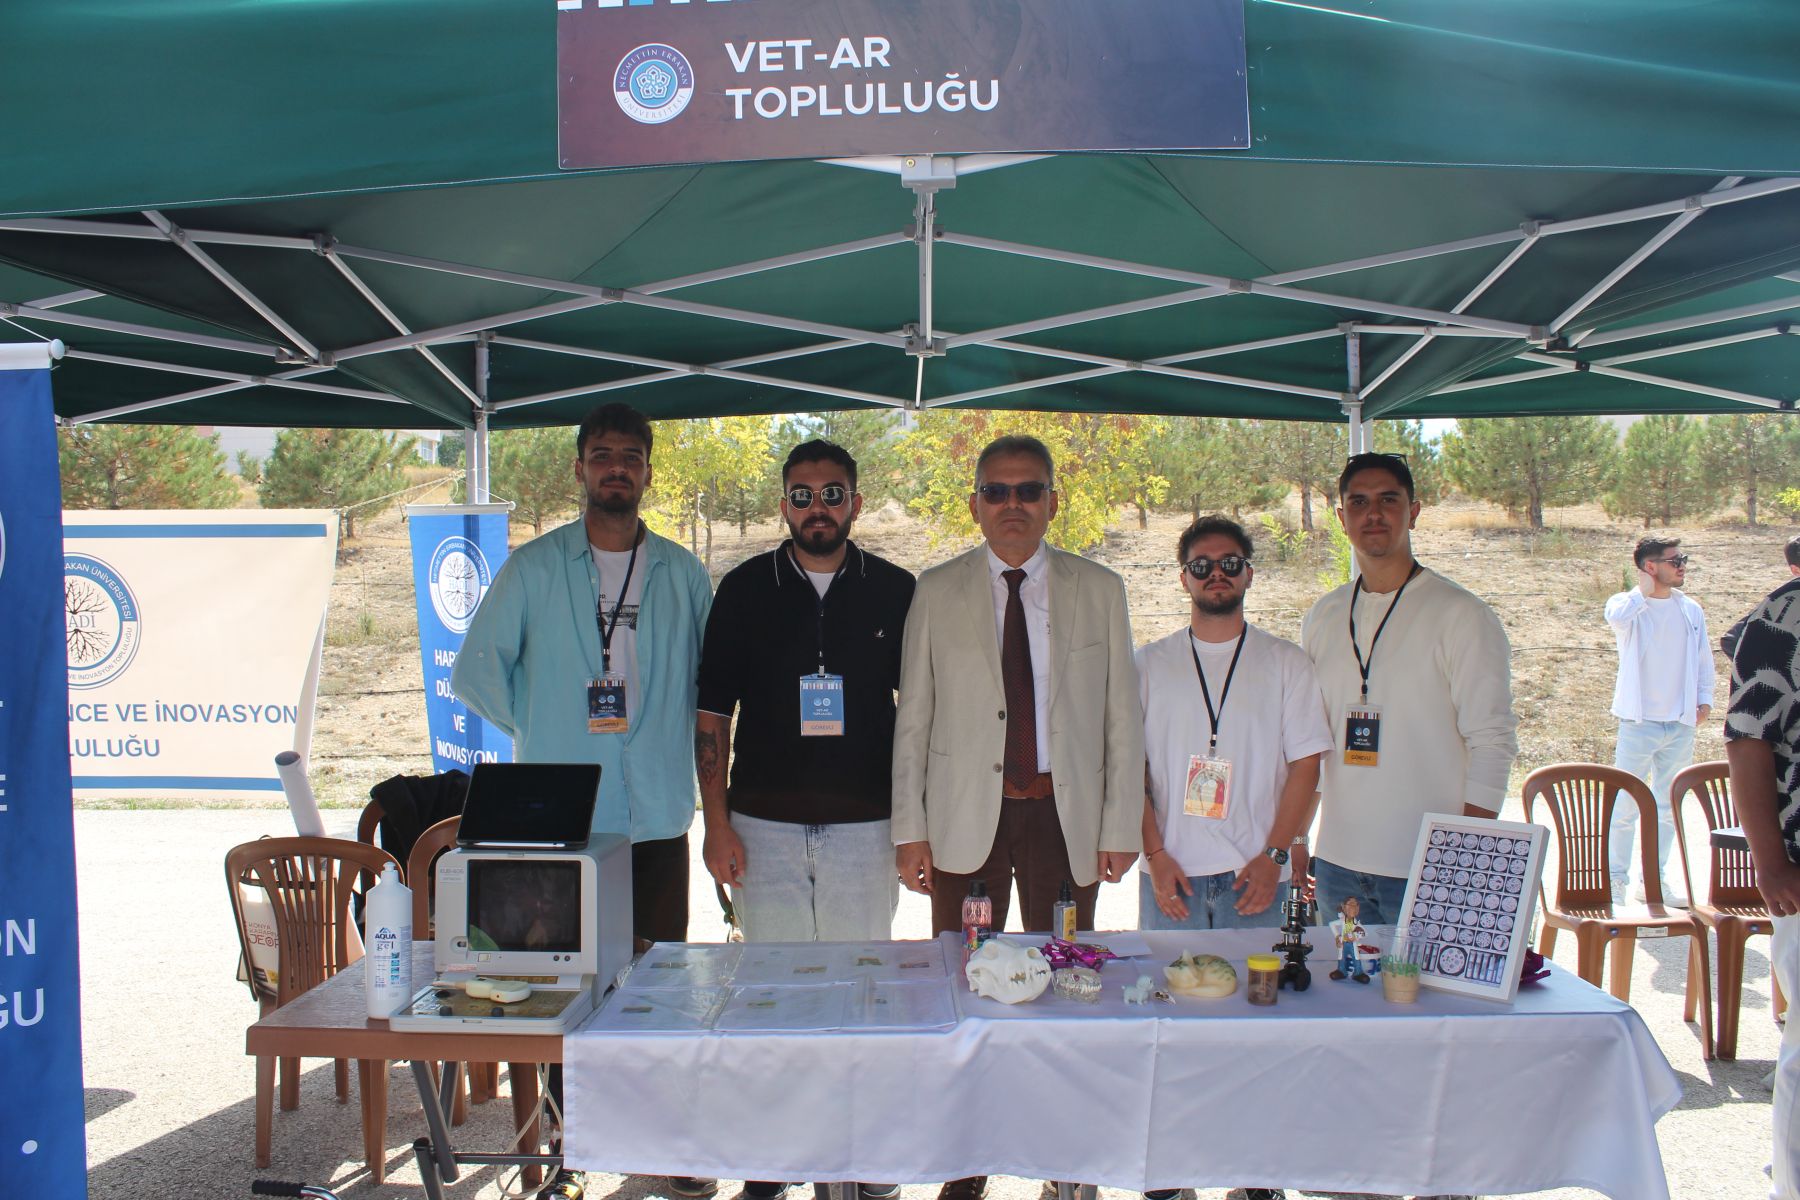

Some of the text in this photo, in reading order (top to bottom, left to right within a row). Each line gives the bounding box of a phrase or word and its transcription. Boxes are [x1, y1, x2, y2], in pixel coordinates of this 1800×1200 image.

[724, 36, 891, 72] VET-AR
[725, 72, 999, 119] TOPLULUĞU
[91, 566, 133, 619] ÜNİVERSİTESİ
[116, 703, 148, 722] VE
[155, 700, 298, 724] İNOVASYON
[453, 714, 465, 733] VE
